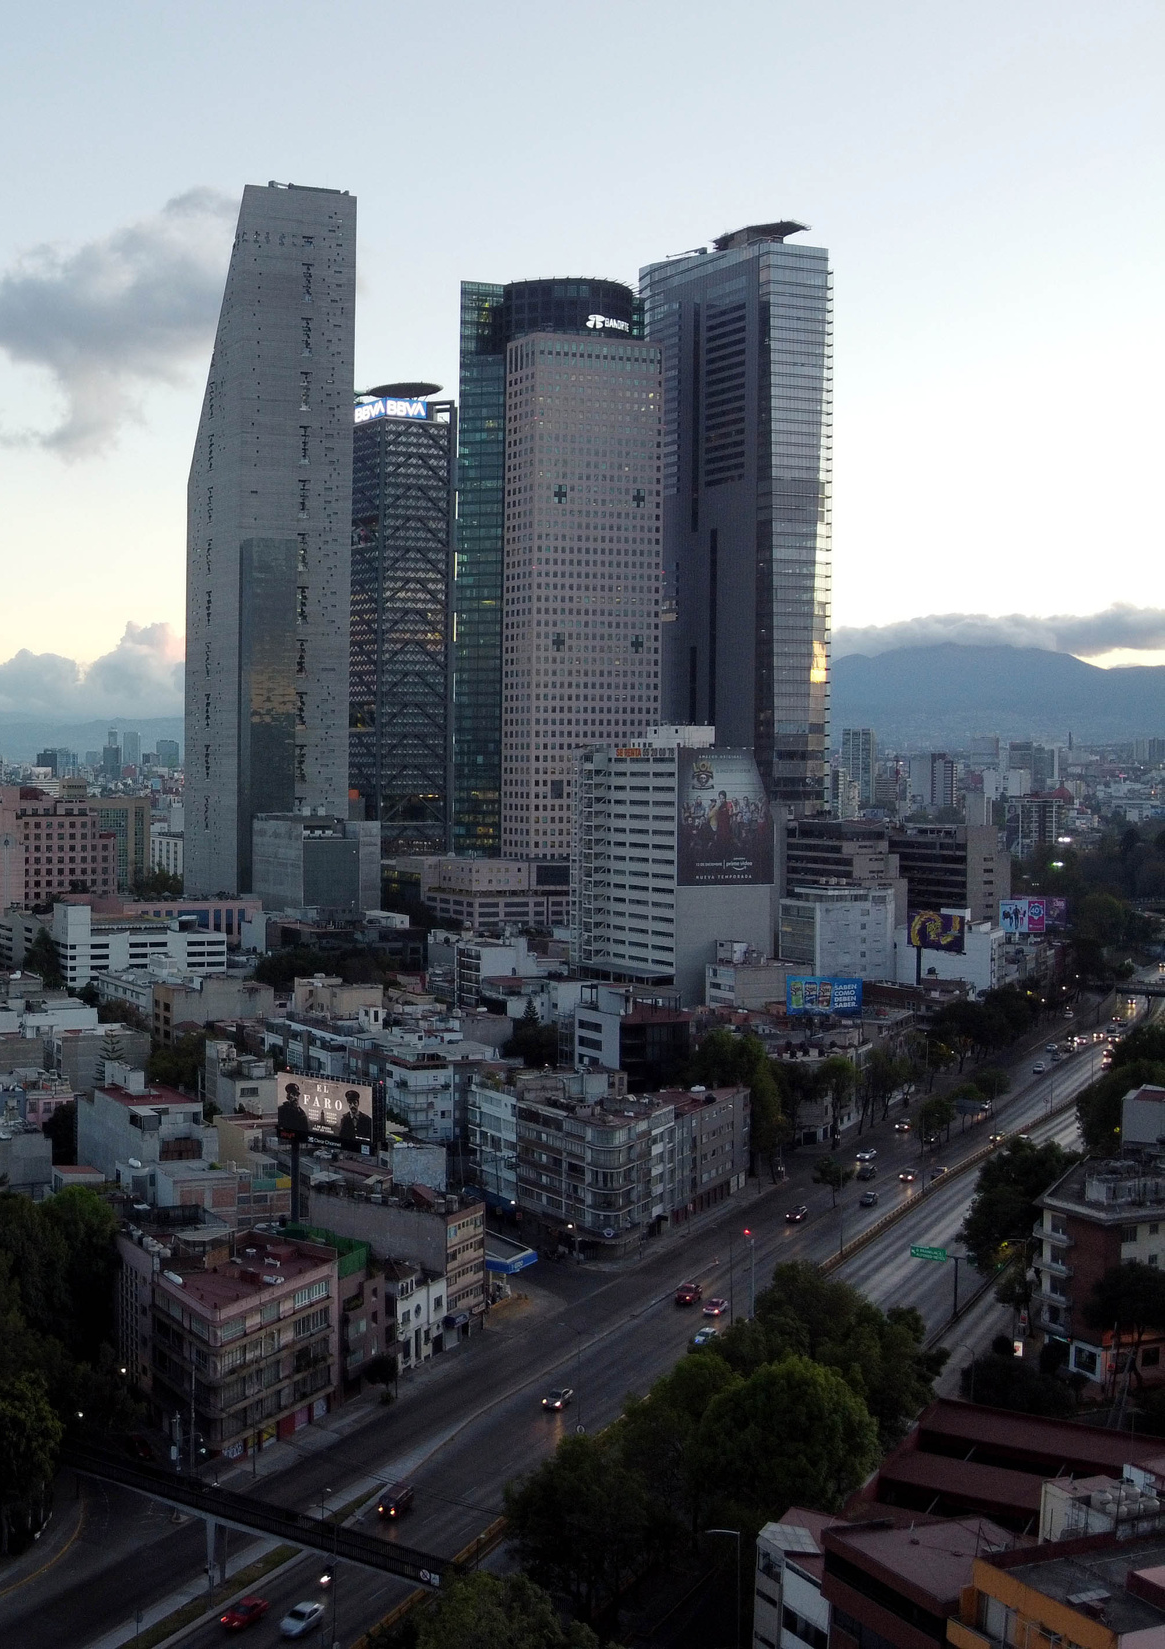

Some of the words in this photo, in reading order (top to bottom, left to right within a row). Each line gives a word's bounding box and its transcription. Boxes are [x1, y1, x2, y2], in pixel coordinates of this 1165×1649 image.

[354, 400, 385, 423] BBVA
[386, 400, 426, 417] BBVA
[616, 748, 624, 757] SE
[316, 1084, 329, 1093] EL
[303, 1094, 343, 1111] FARO
[324, 1139, 342, 1147] Channel
